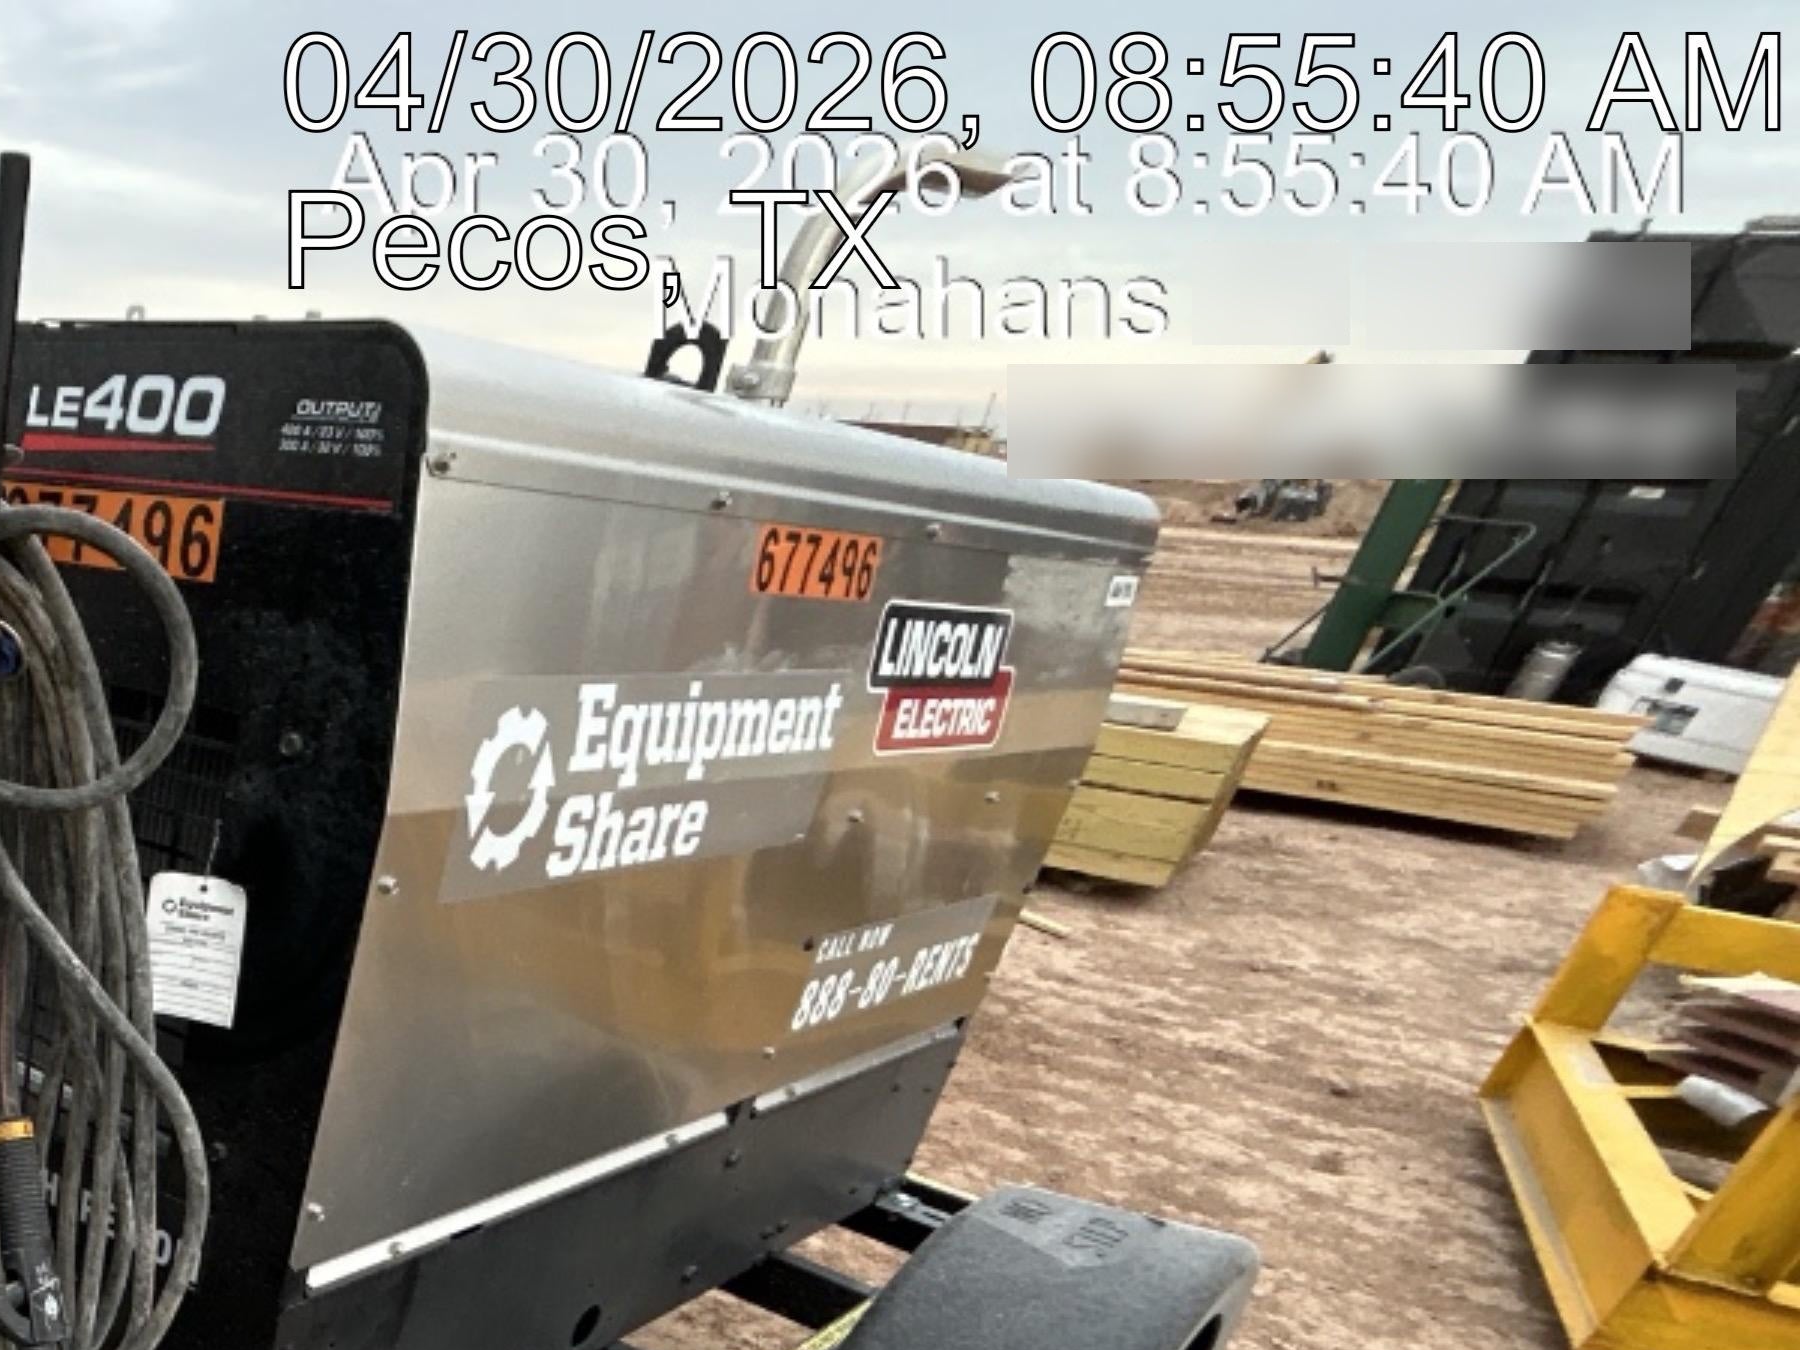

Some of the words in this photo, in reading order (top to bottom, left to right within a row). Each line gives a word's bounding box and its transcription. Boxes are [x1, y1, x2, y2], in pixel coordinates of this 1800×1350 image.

[26, 374, 227, 436] LE400
[757, 526, 877, 599] 677496
[878, 618, 1002, 680] LINCOLN
[568, 682, 843, 791] Equipment
[891, 697, 996, 740] ELECTRIC
[546, 794, 709, 879] Share
[791, 932, 980, 1030] 888-80-RENTS
